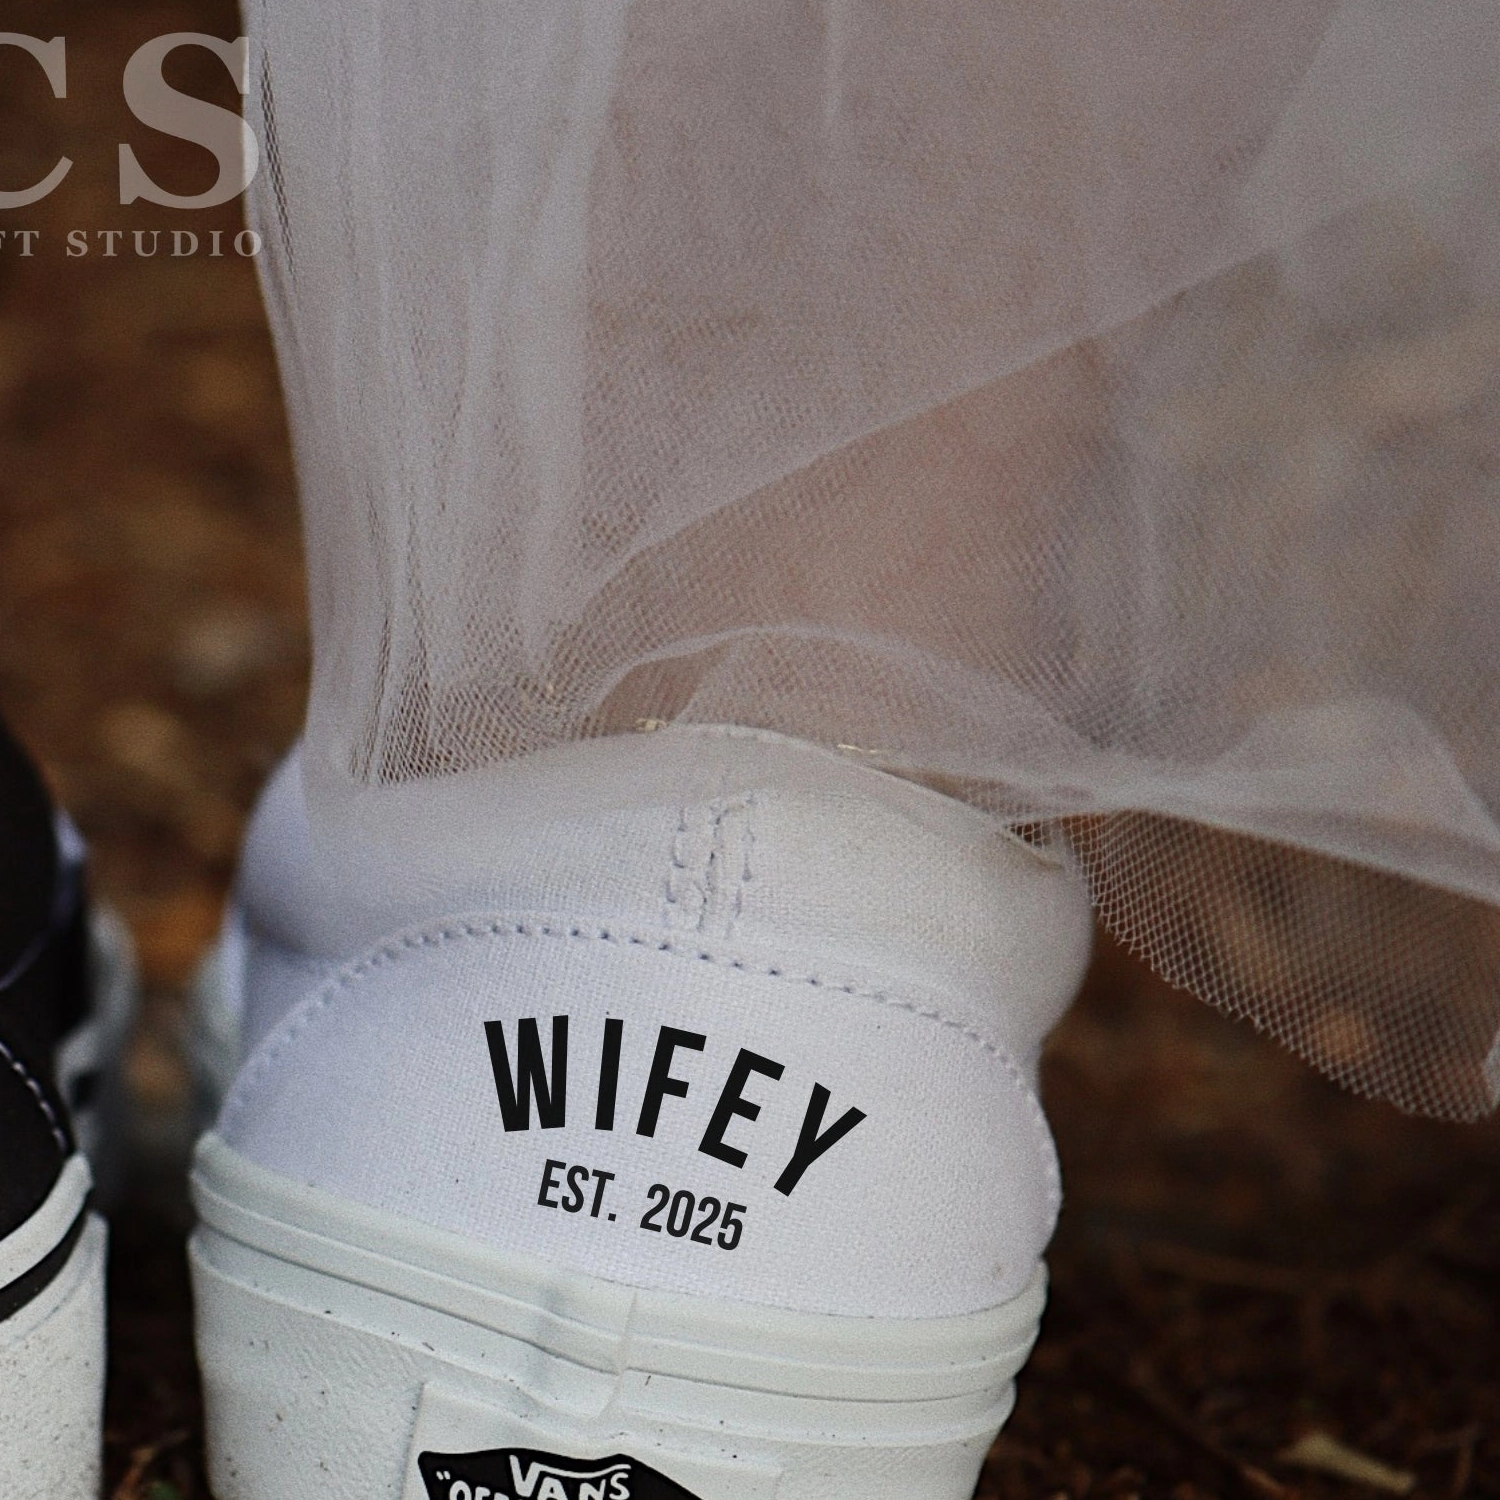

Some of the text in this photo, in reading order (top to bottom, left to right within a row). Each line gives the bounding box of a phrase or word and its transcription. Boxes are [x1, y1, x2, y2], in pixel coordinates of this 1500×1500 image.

[484, 1015, 867, 1197] WIFEY
[537, 1159, 747, 1251] EST. 2025
